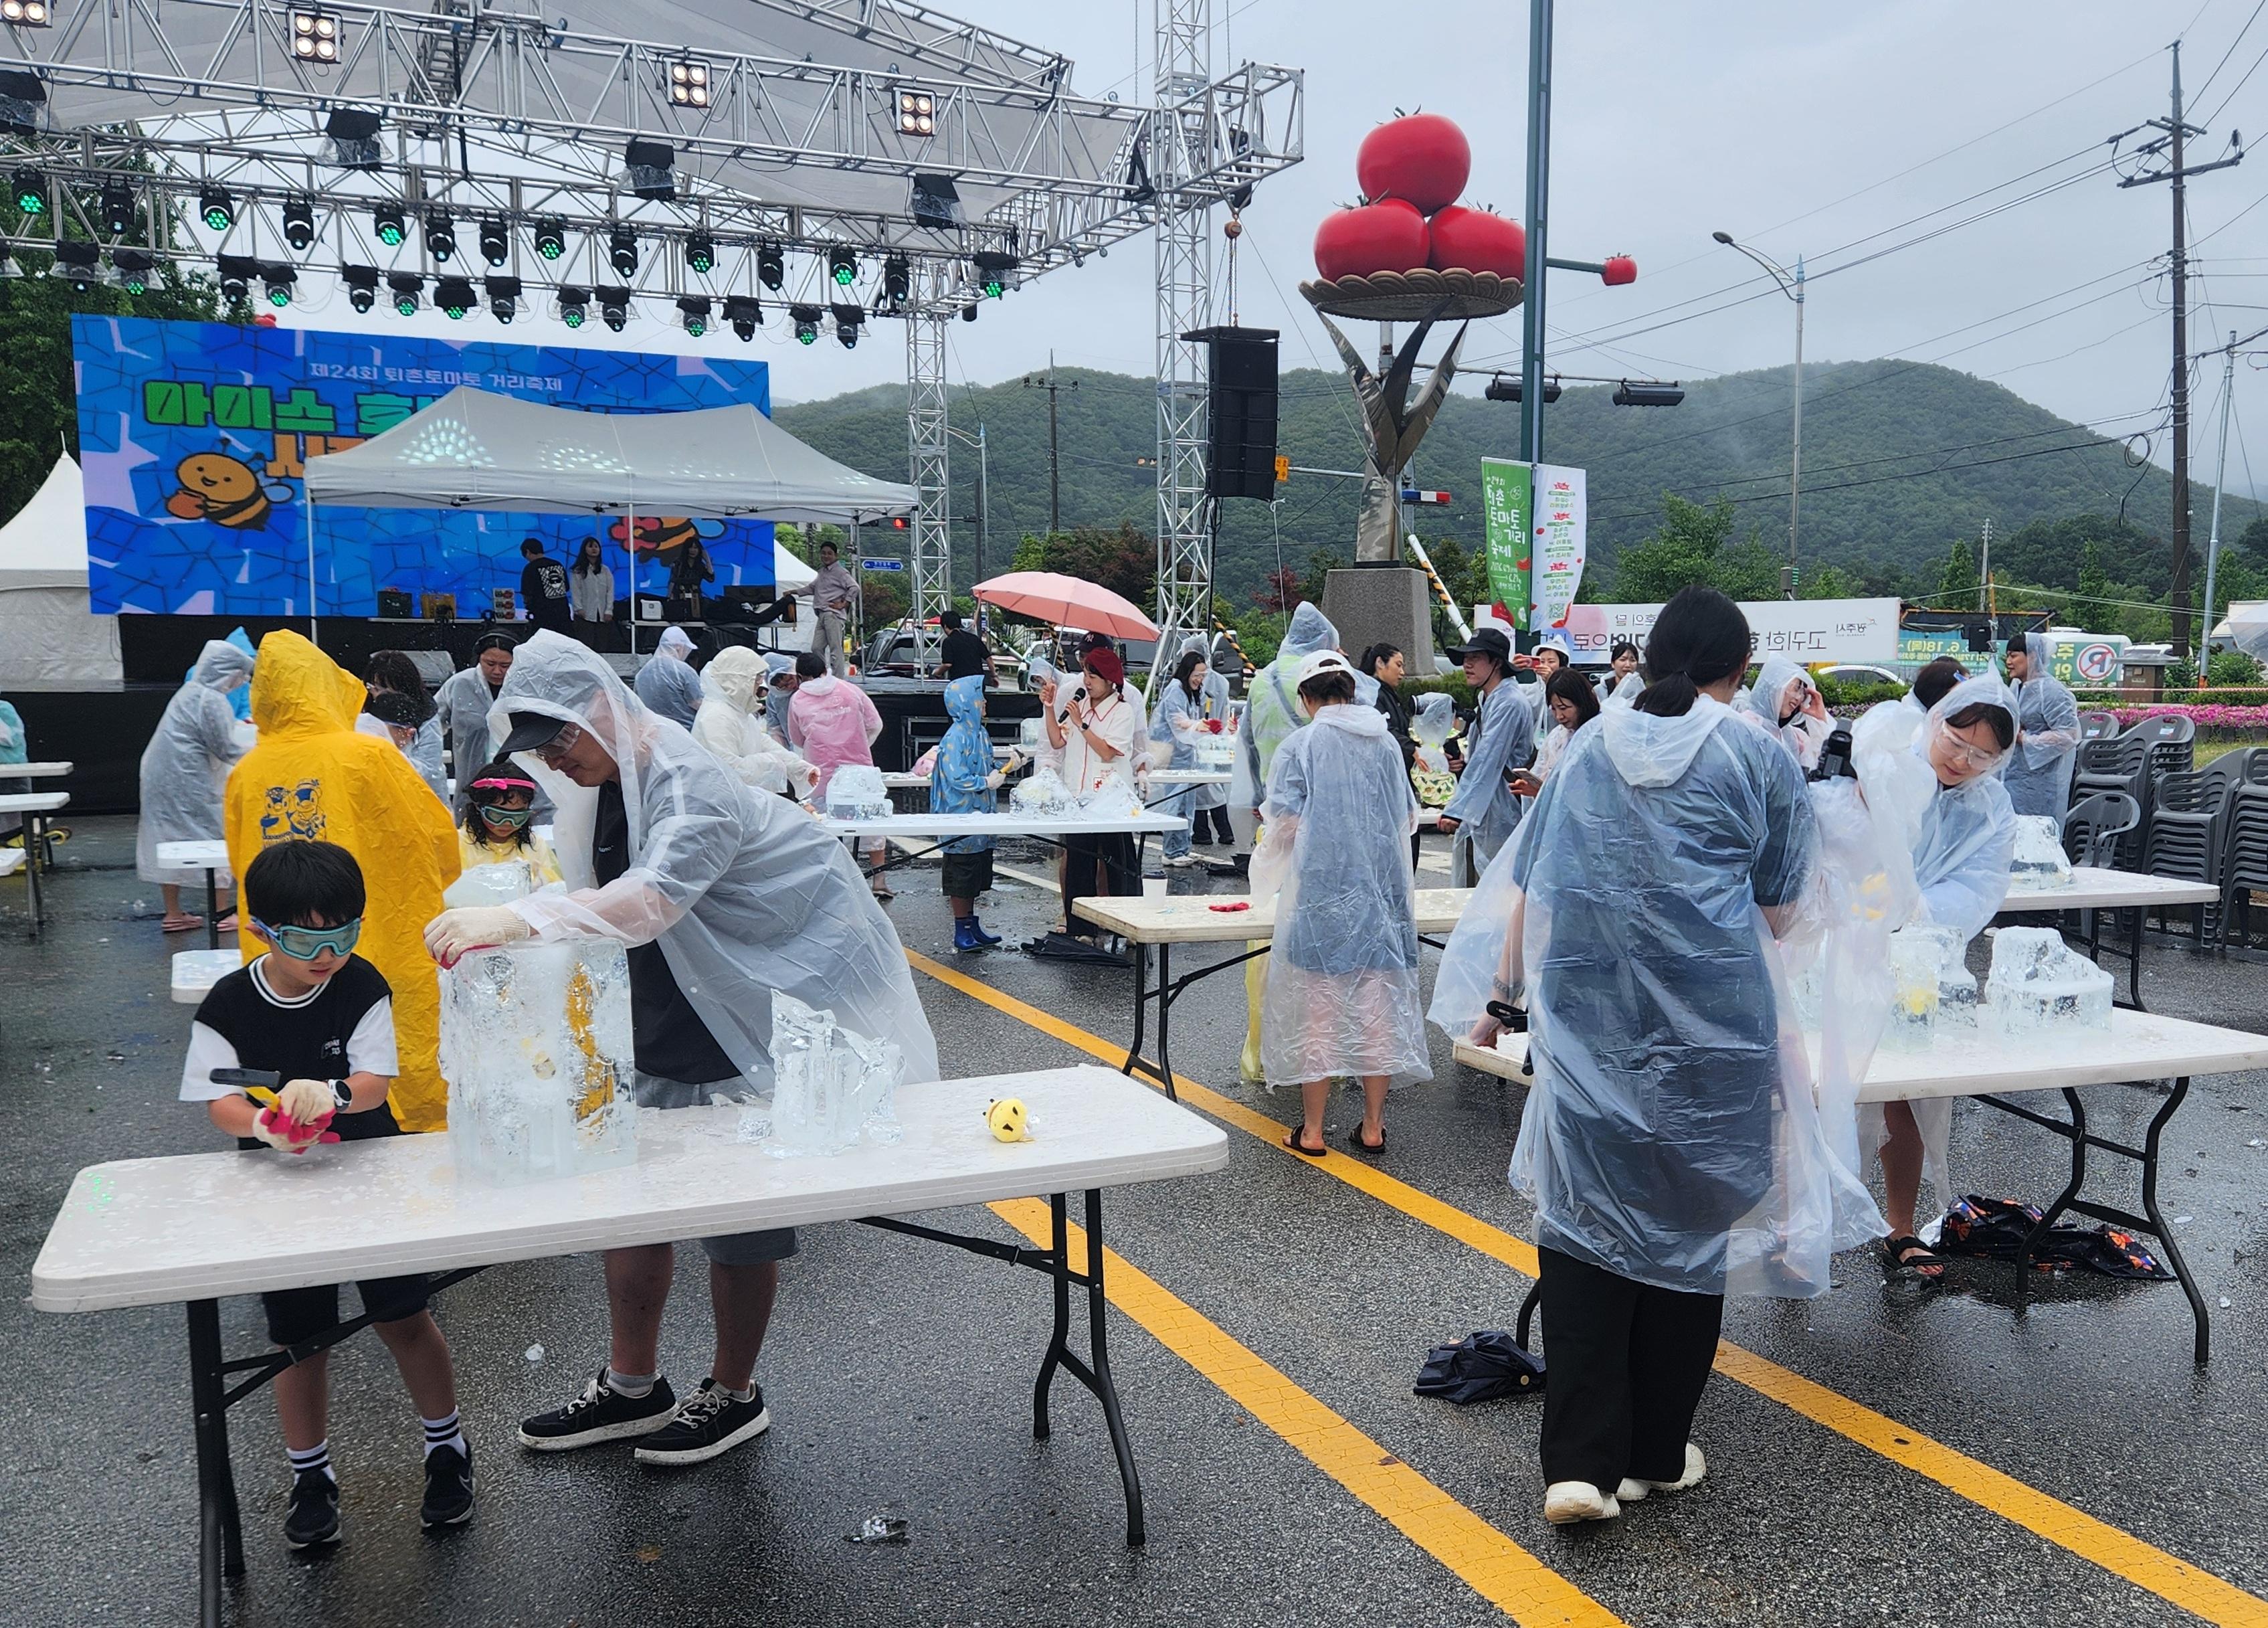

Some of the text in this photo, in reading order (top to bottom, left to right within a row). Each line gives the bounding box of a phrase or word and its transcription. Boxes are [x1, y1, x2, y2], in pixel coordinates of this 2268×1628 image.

[309, 363, 562, 391] 제24회 퇴촌토마토 거리축제
[144, 380, 335, 432] 아이스
[1491, 507, 1521, 529] 토마토
[1503, 529, 1525, 545] 거리
[1491, 538, 1511, 559] 축제
